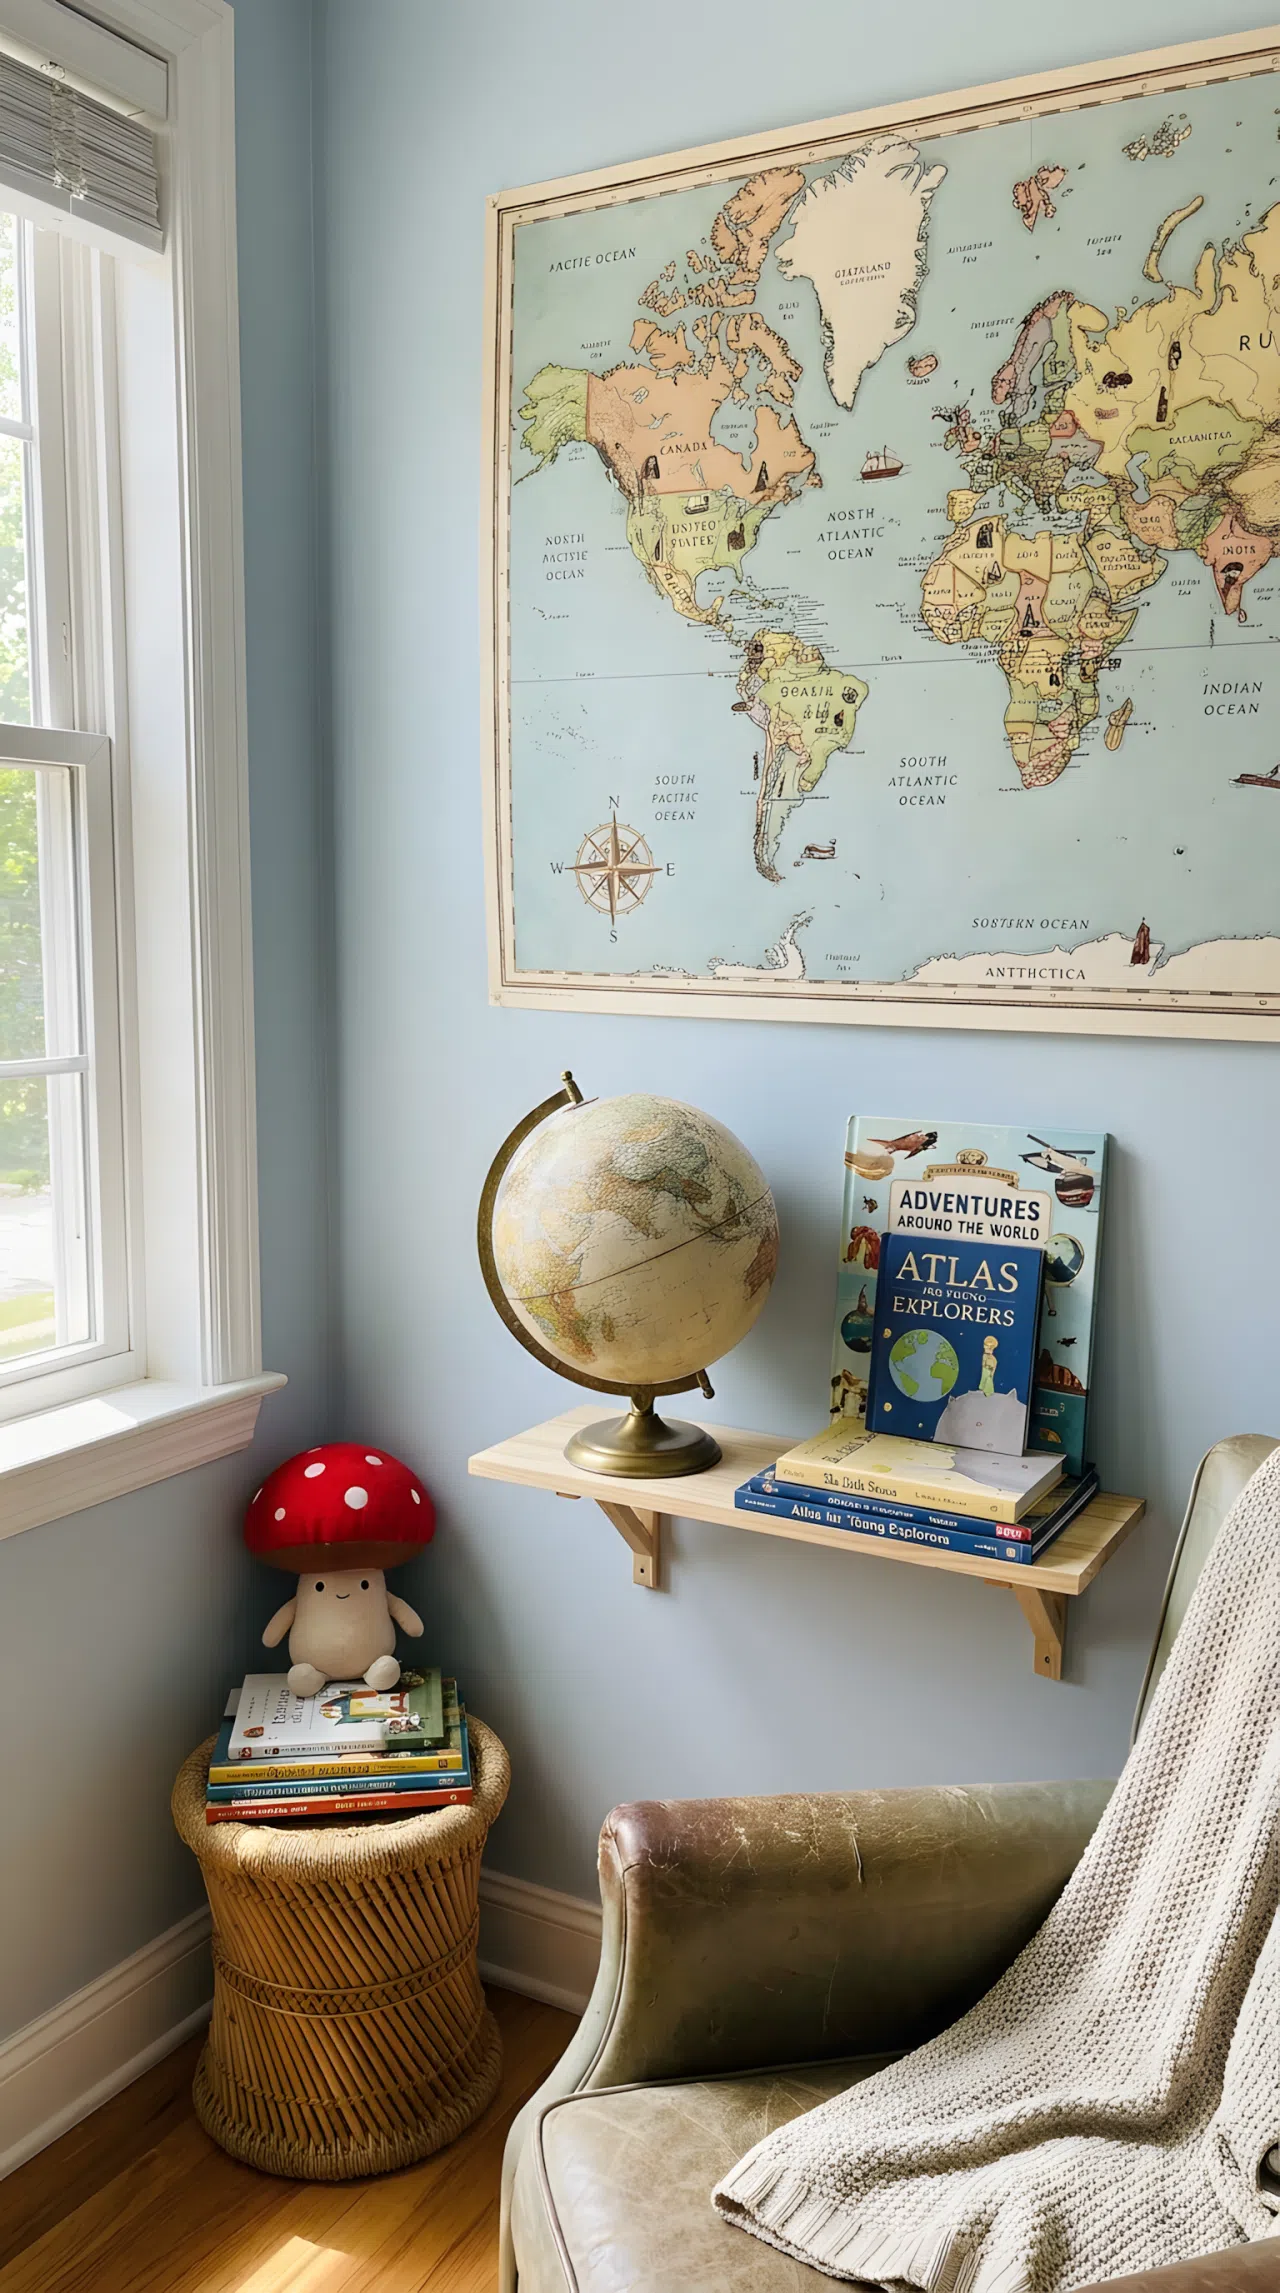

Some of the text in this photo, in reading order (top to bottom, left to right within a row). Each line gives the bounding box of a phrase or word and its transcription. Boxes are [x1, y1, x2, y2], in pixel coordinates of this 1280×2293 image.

[595, 247, 637, 264] OCEAN
[660, 442, 708, 456] CANADA
[816, 526, 885, 542] ATLANTIC
[827, 547, 874, 561] OCEAN
[1203, 681, 1263, 695] INDIAN
[1204, 702, 1260, 716] OCEAN
[899, 755, 947, 768] SOUTH
[655, 774, 696, 786] SOUTH
[887, 774, 958, 787] ATLANTIC
[608, 795, 620, 810] N
[899, 795, 946, 806] OCEAN
[550, 861, 564, 875] W
[666, 862, 676, 877] E
[1040, 919, 1090, 930] OCEAN
[609, 929, 618, 943] S
[900, 1189, 1040, 1221] ADVENTURES
[958, 1220, 984, 1235] THE
[990, 1223, 1039, 1241] WORLD
[895, 1251, 1019, 1293] ATLAS
[892, 1295, 1015, 1327] EXPLORERS
